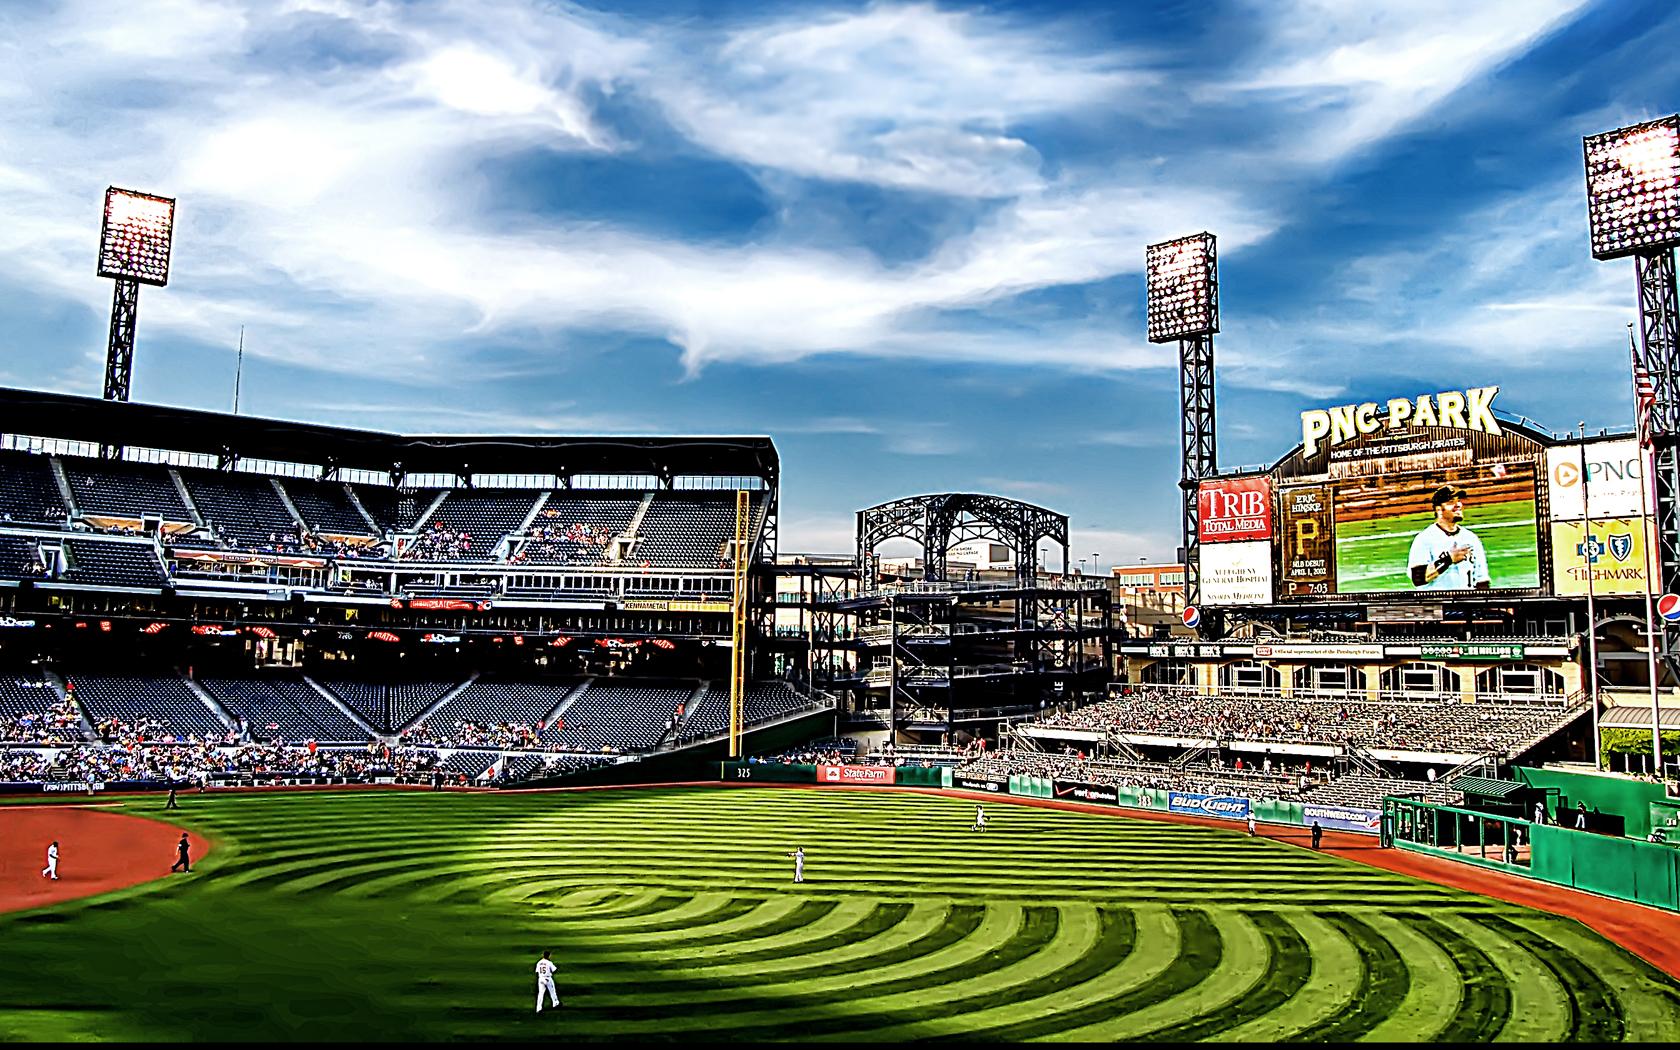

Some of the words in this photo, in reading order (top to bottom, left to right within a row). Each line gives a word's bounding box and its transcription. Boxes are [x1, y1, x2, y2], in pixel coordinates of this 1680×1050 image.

[1301, 402, 1379, 459] PNC
[1387, 386, 1502, 437] PARK
[1330, 450, 1352, 459] HOME
[1353, 448, 1364, 457] OF
[1365, 446, 1381, 455] THE
[1381, 441, 1430, 454] PITTSBURGH
[1431, 438, 1466, 449] PIRATES
[1586, 458, 1642, 482] PNC
[1296, 494, 1316, 504] ERIC
[1296, 517, 1319, 555] P
[1308, 583, 1329, 594] 7:03
[625, 602, 667, 611] KENNAMETAL
[737, 768, 750, 778] 325
[1074, 788, 1100, 799] verizon
[1171, 796, 1201, 808] BUD
[1205, 800, 1246, 813] LIGHT
